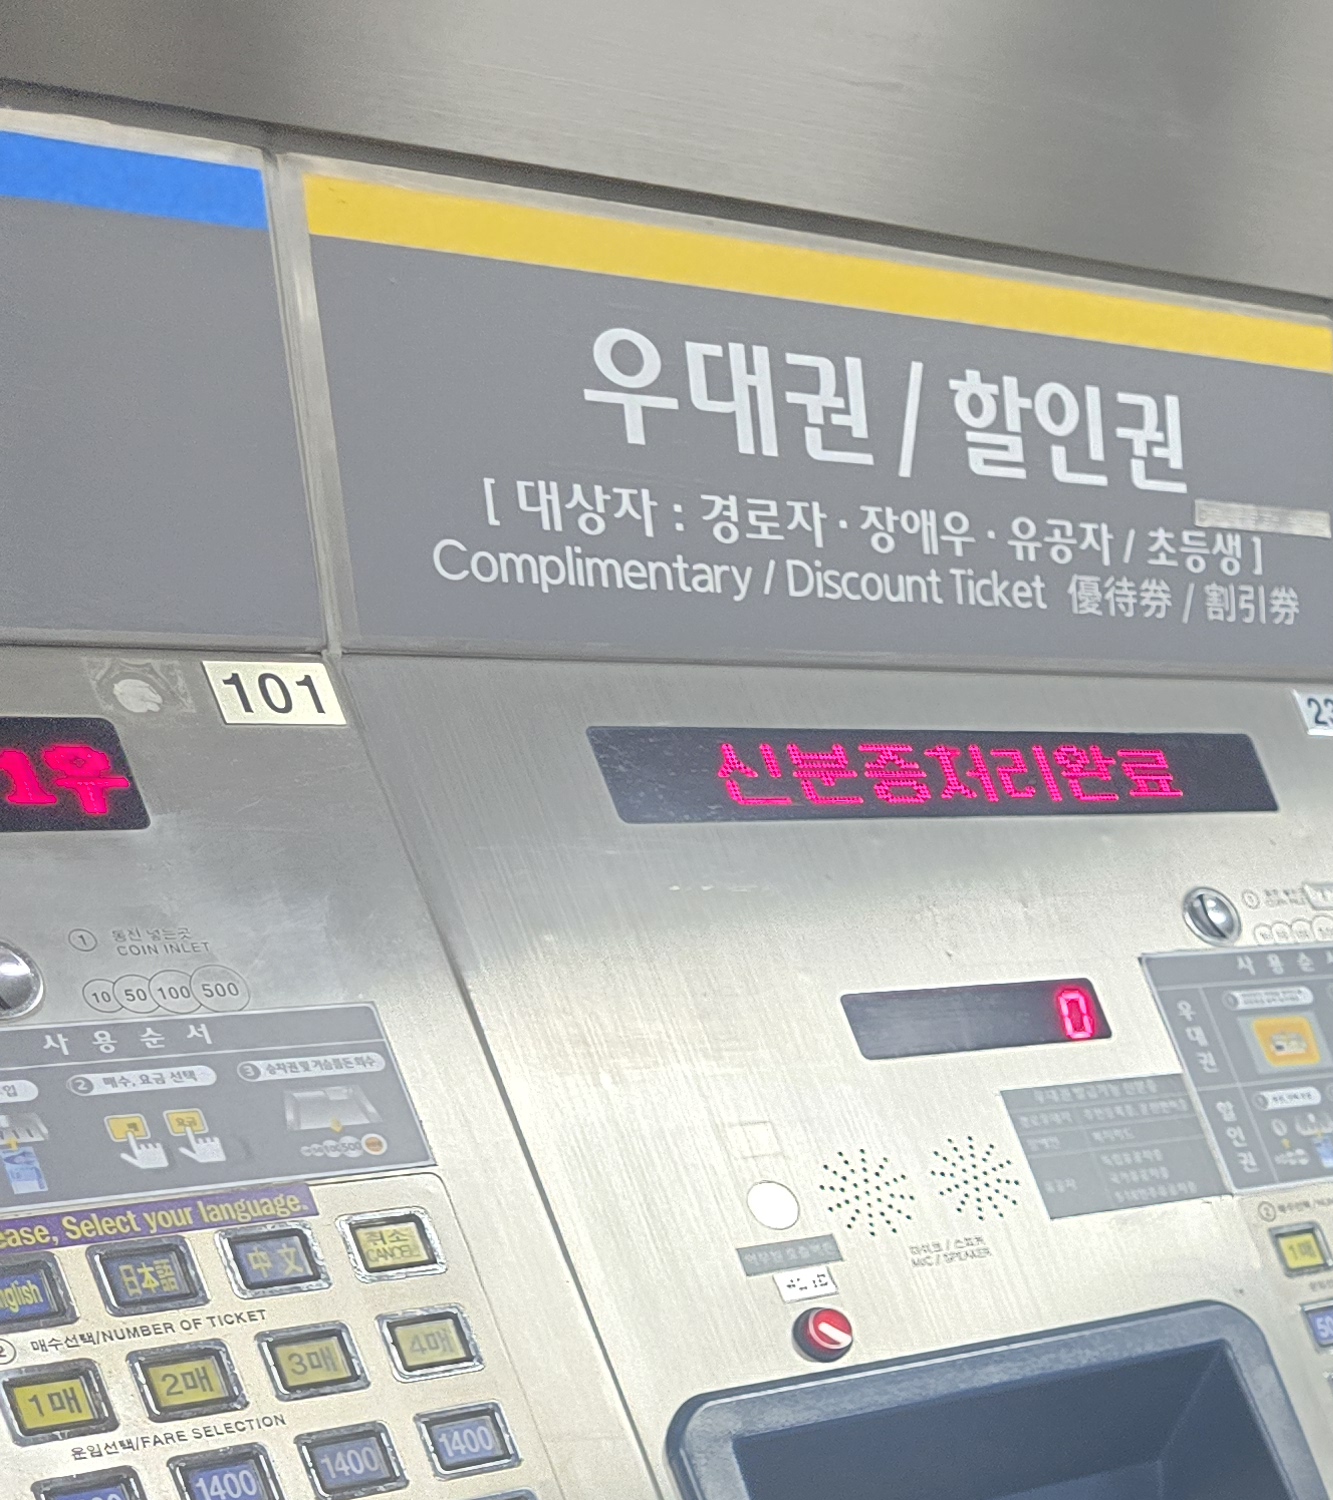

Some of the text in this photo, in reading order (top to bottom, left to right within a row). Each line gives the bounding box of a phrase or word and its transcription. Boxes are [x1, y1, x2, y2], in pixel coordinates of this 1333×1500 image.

[583, 327, 874, 465] 우대권
[948, 368, 1188, 494] 할인권
[515, 479, 658, 539] 대상자
[1147, 526, 1244, 578] 초등생
[432, 538, 753, 603] Complimentary
[786, 558, 944, 604] Discount
[949, 566, 1048, 612] Ticket
[222, 671, 327, 715] 101
[716, 741, 1185, 806] 신분증처리완료
[116, 940, 212, 958] COIN INLET
[91, 981, 240, 1004] 10 50 100 500
[1054, 986, 1098, 1043] 0
[60, 1206, 142, 1241] Select
[148, 1205, 193, 1235] your
[197, 1191, 310, 1225] language.
[246, 1242, 303, 1278] 中文
[365, 1243, 423, 1265] CANCEL
[118, 1259, 177, 1297] 日本語
[181, 1317, 203, 1332] OF
[206, 1308, 268, 1327] TICKET
[409, 1330, 455, 1357] 4매
[287, 1348, 338, 1377] 3매
[160, 1366, 213, 1397] 2매
[28, 1387, 83, 1418] 1매
[193, 1413, 288, 1440] SELECTION
[438, 1426, 494, 1457] 1400
[321, 1446, 378, 1478] 1400
